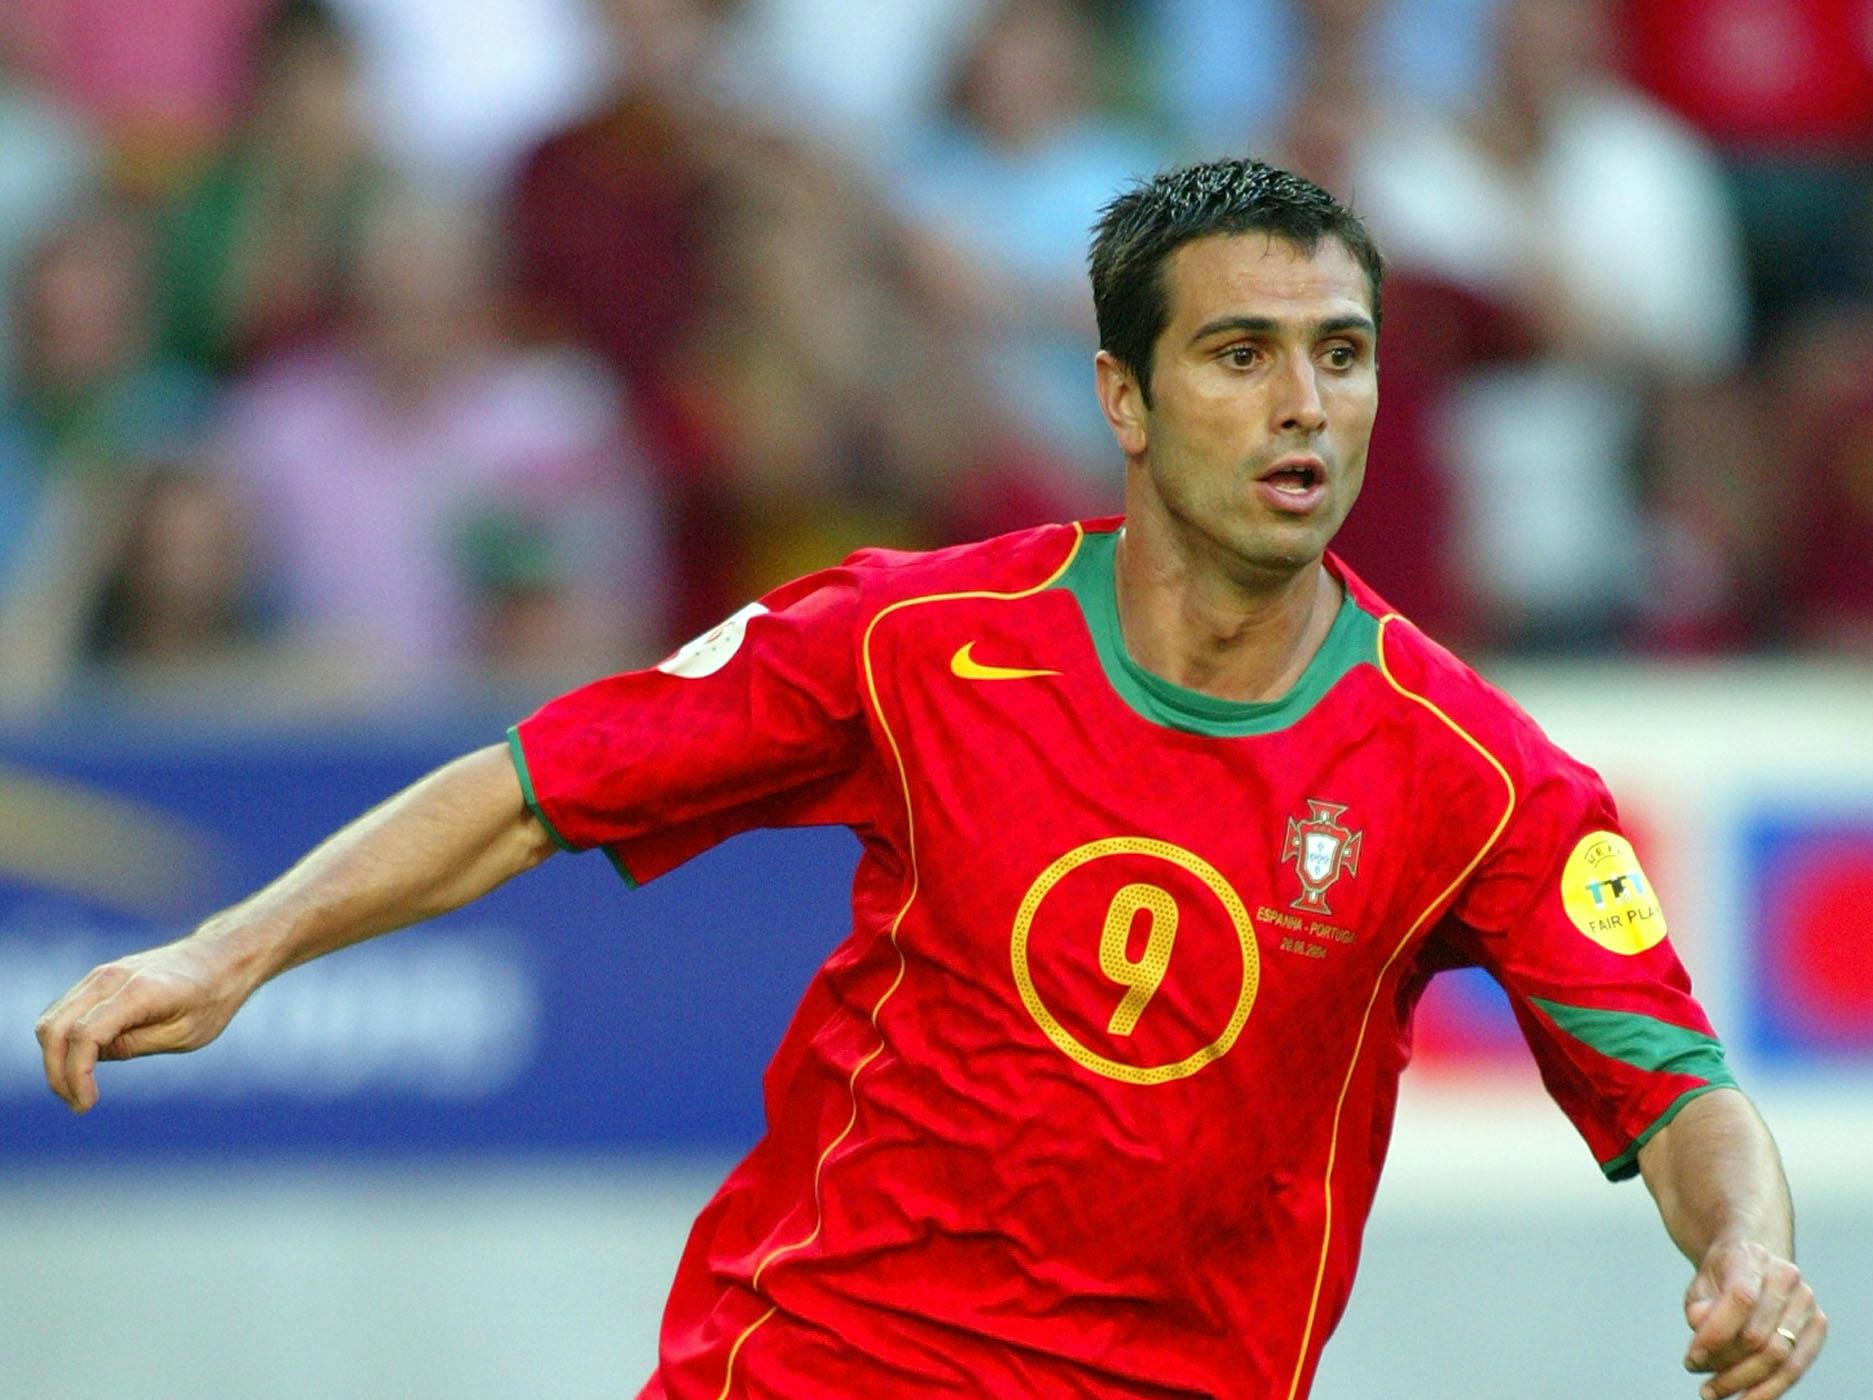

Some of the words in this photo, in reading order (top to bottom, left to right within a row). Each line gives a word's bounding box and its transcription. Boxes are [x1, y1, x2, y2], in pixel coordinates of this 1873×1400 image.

[1309, 922, 1355, 944] PORTUGA
[1588, 915, 1623, 933] FAIR
[1627, 907, 1659, 923] PLA
[1100, 883, 1179, 1037] 9
